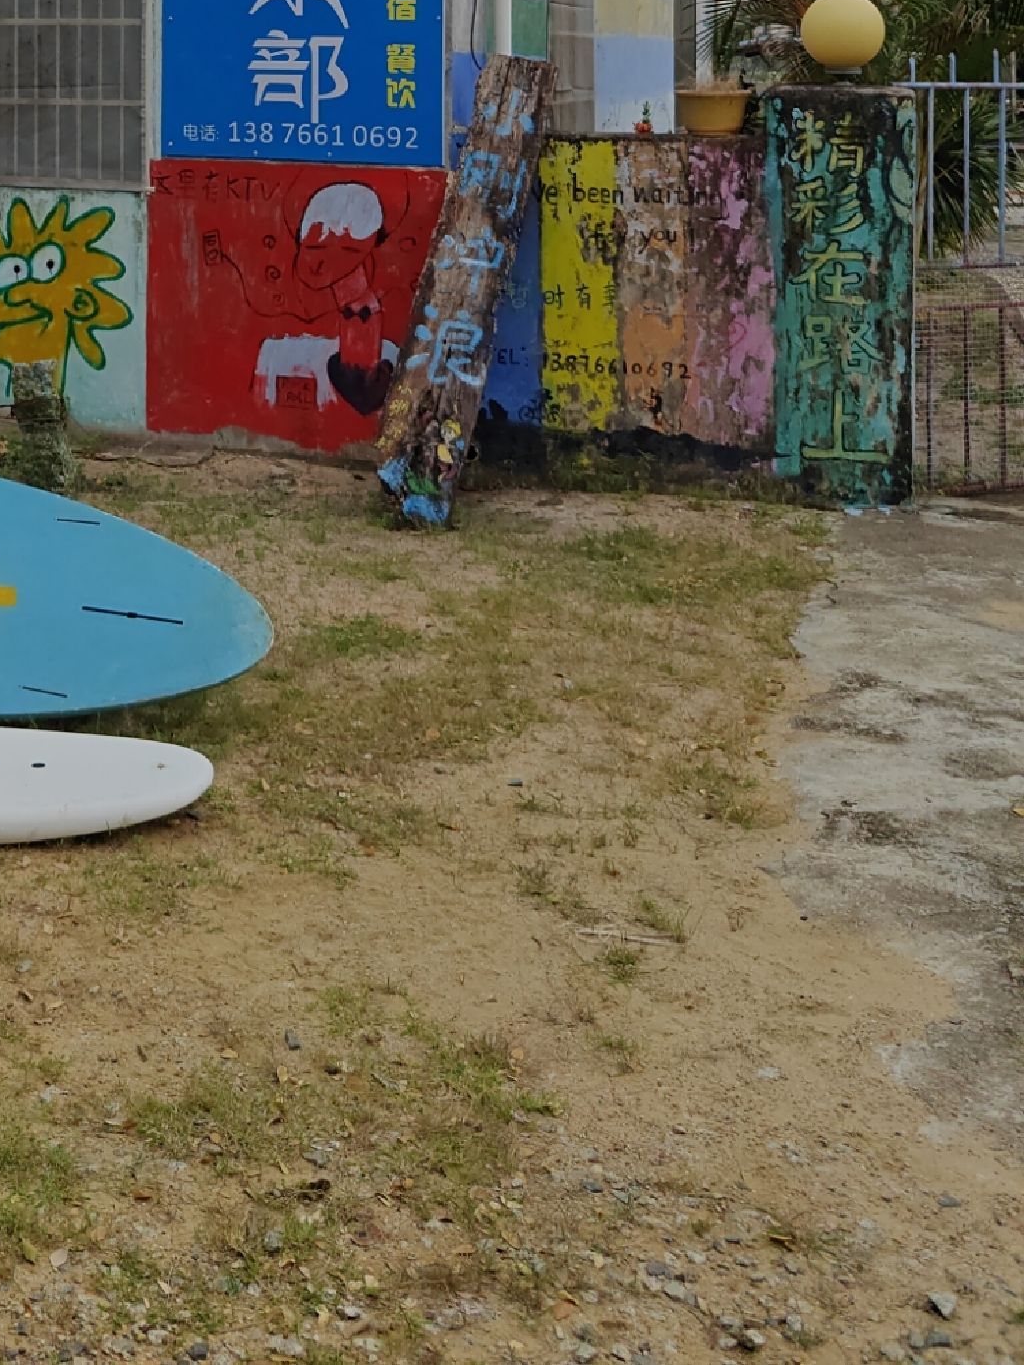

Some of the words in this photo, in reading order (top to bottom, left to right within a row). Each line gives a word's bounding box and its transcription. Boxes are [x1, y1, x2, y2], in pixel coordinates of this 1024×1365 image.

[386, 43, 417, 110] 餐饮
[228, 121, 274, 144] 138
[280, 123, 345, 147] 7661
[353, 125, 419, 149] 0692
[571, 172, 624, 205] been
[640, 227, 678, 255] you
[789, 109, 893, 464] 精彩在路上
